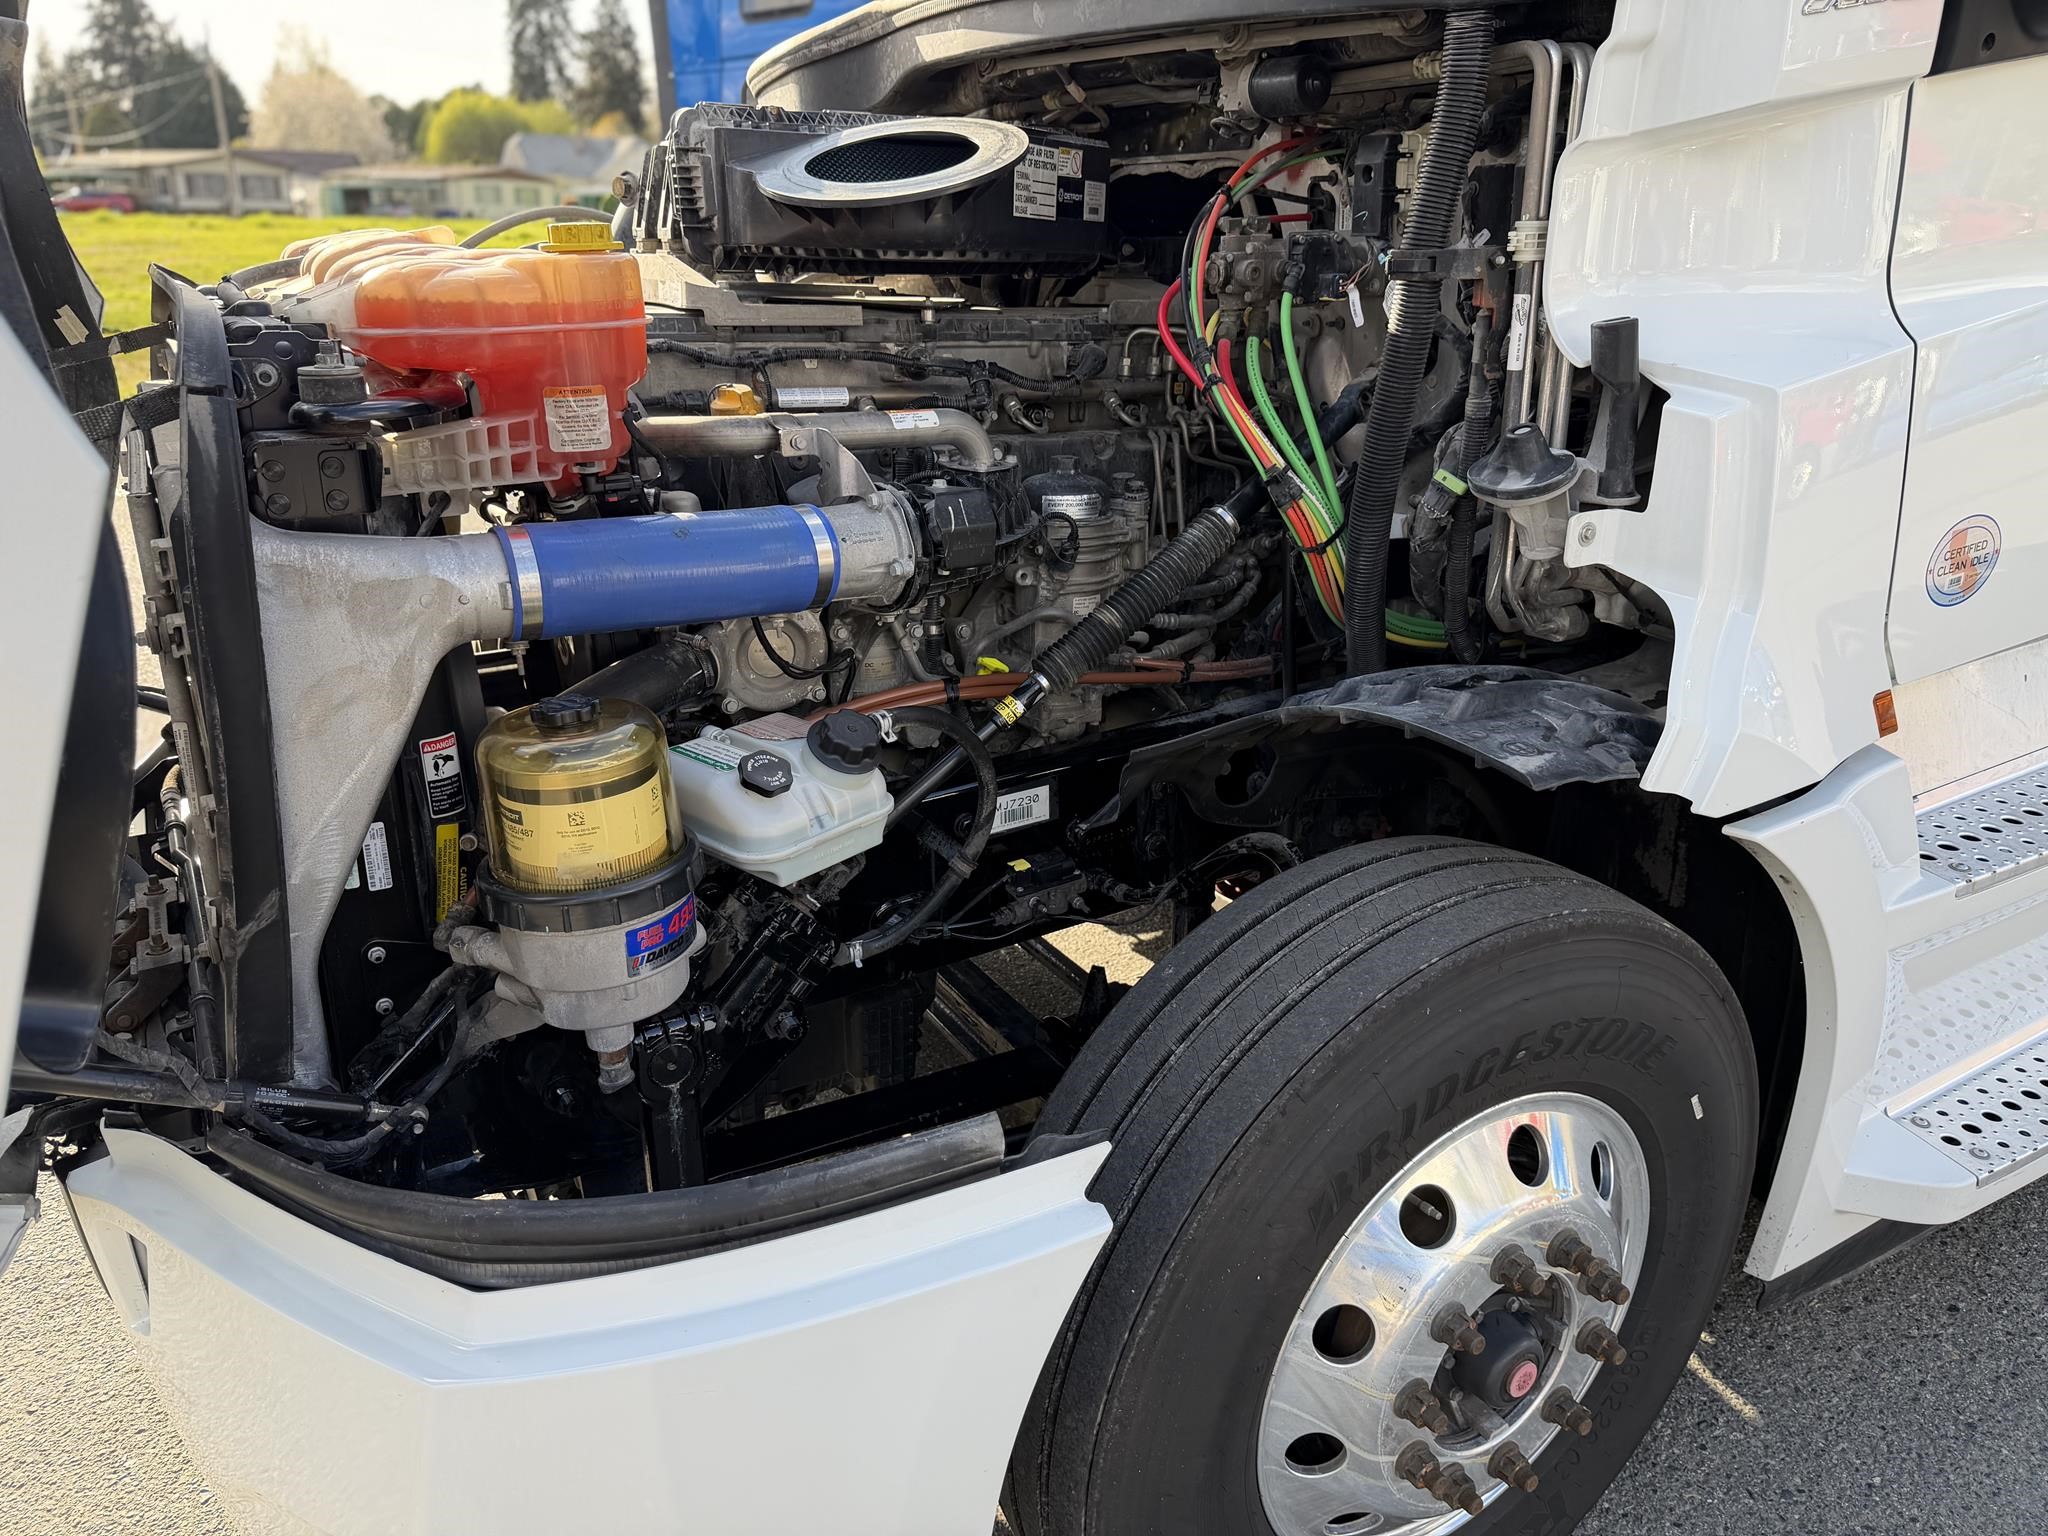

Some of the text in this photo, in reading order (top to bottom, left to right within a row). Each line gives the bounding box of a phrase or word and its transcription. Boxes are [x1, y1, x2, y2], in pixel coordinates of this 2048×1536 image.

[1944, 539, 1989, 562] CERTIFIED
[1937, 559, 1968, 577] CLEAN
[1970, 552, 1990, 568] IDLE
[430, 737, 456, 751] DANGER
[1310, 1016, 1680, 1238] BRIDGESTONE
